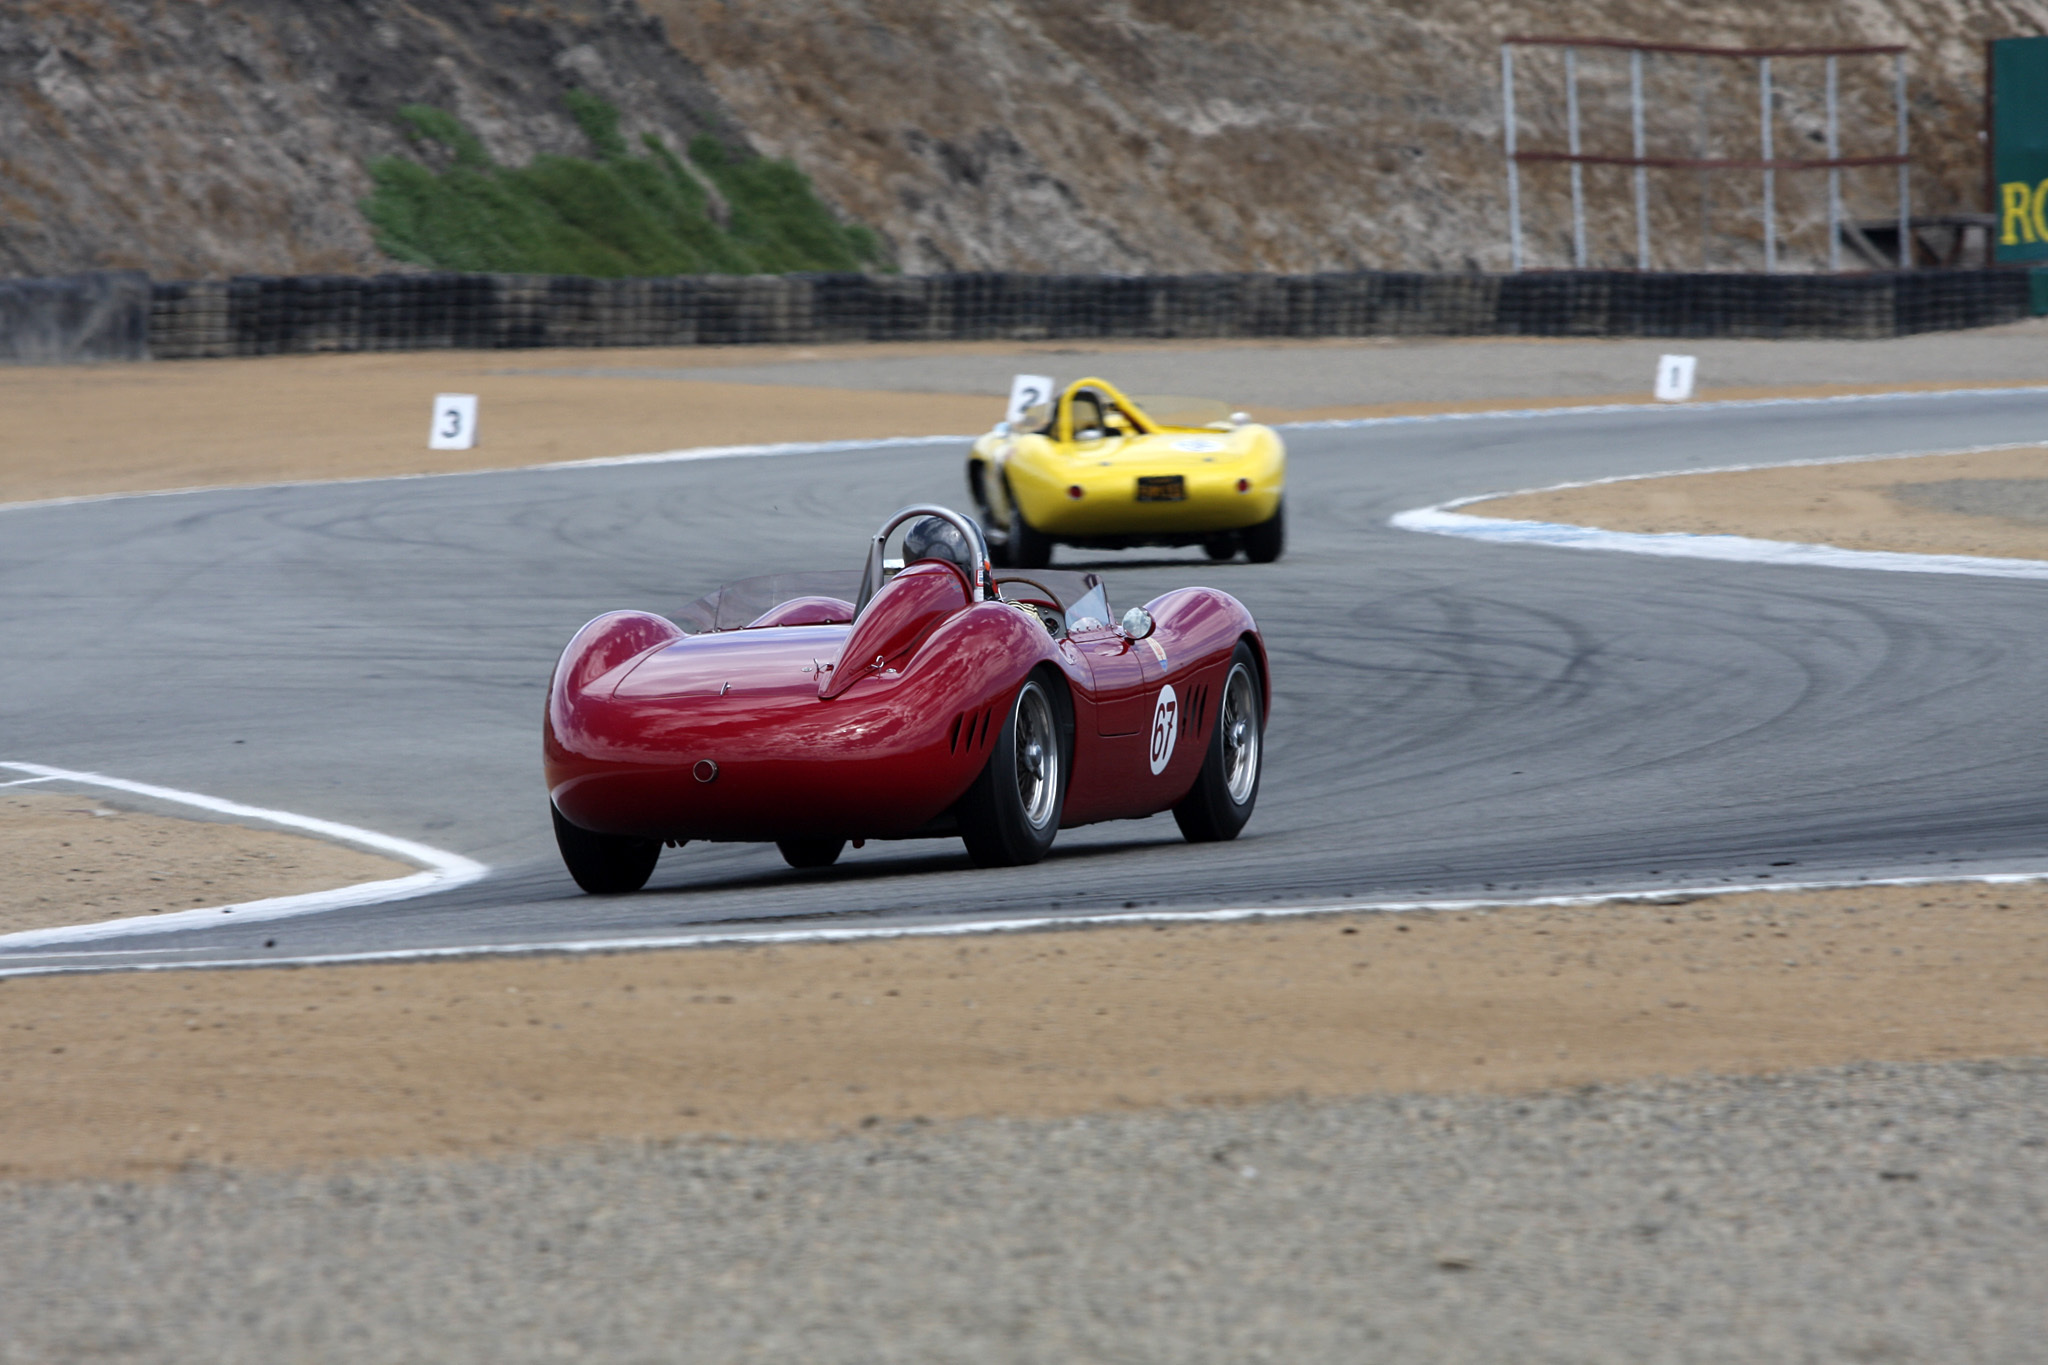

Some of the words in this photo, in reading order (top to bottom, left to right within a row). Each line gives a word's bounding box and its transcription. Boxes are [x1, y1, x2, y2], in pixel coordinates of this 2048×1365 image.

[1018, 386, 1040, 414] 2
[441, 409, 462, 438] 3
[1152, 701, 1176, 763] 67
